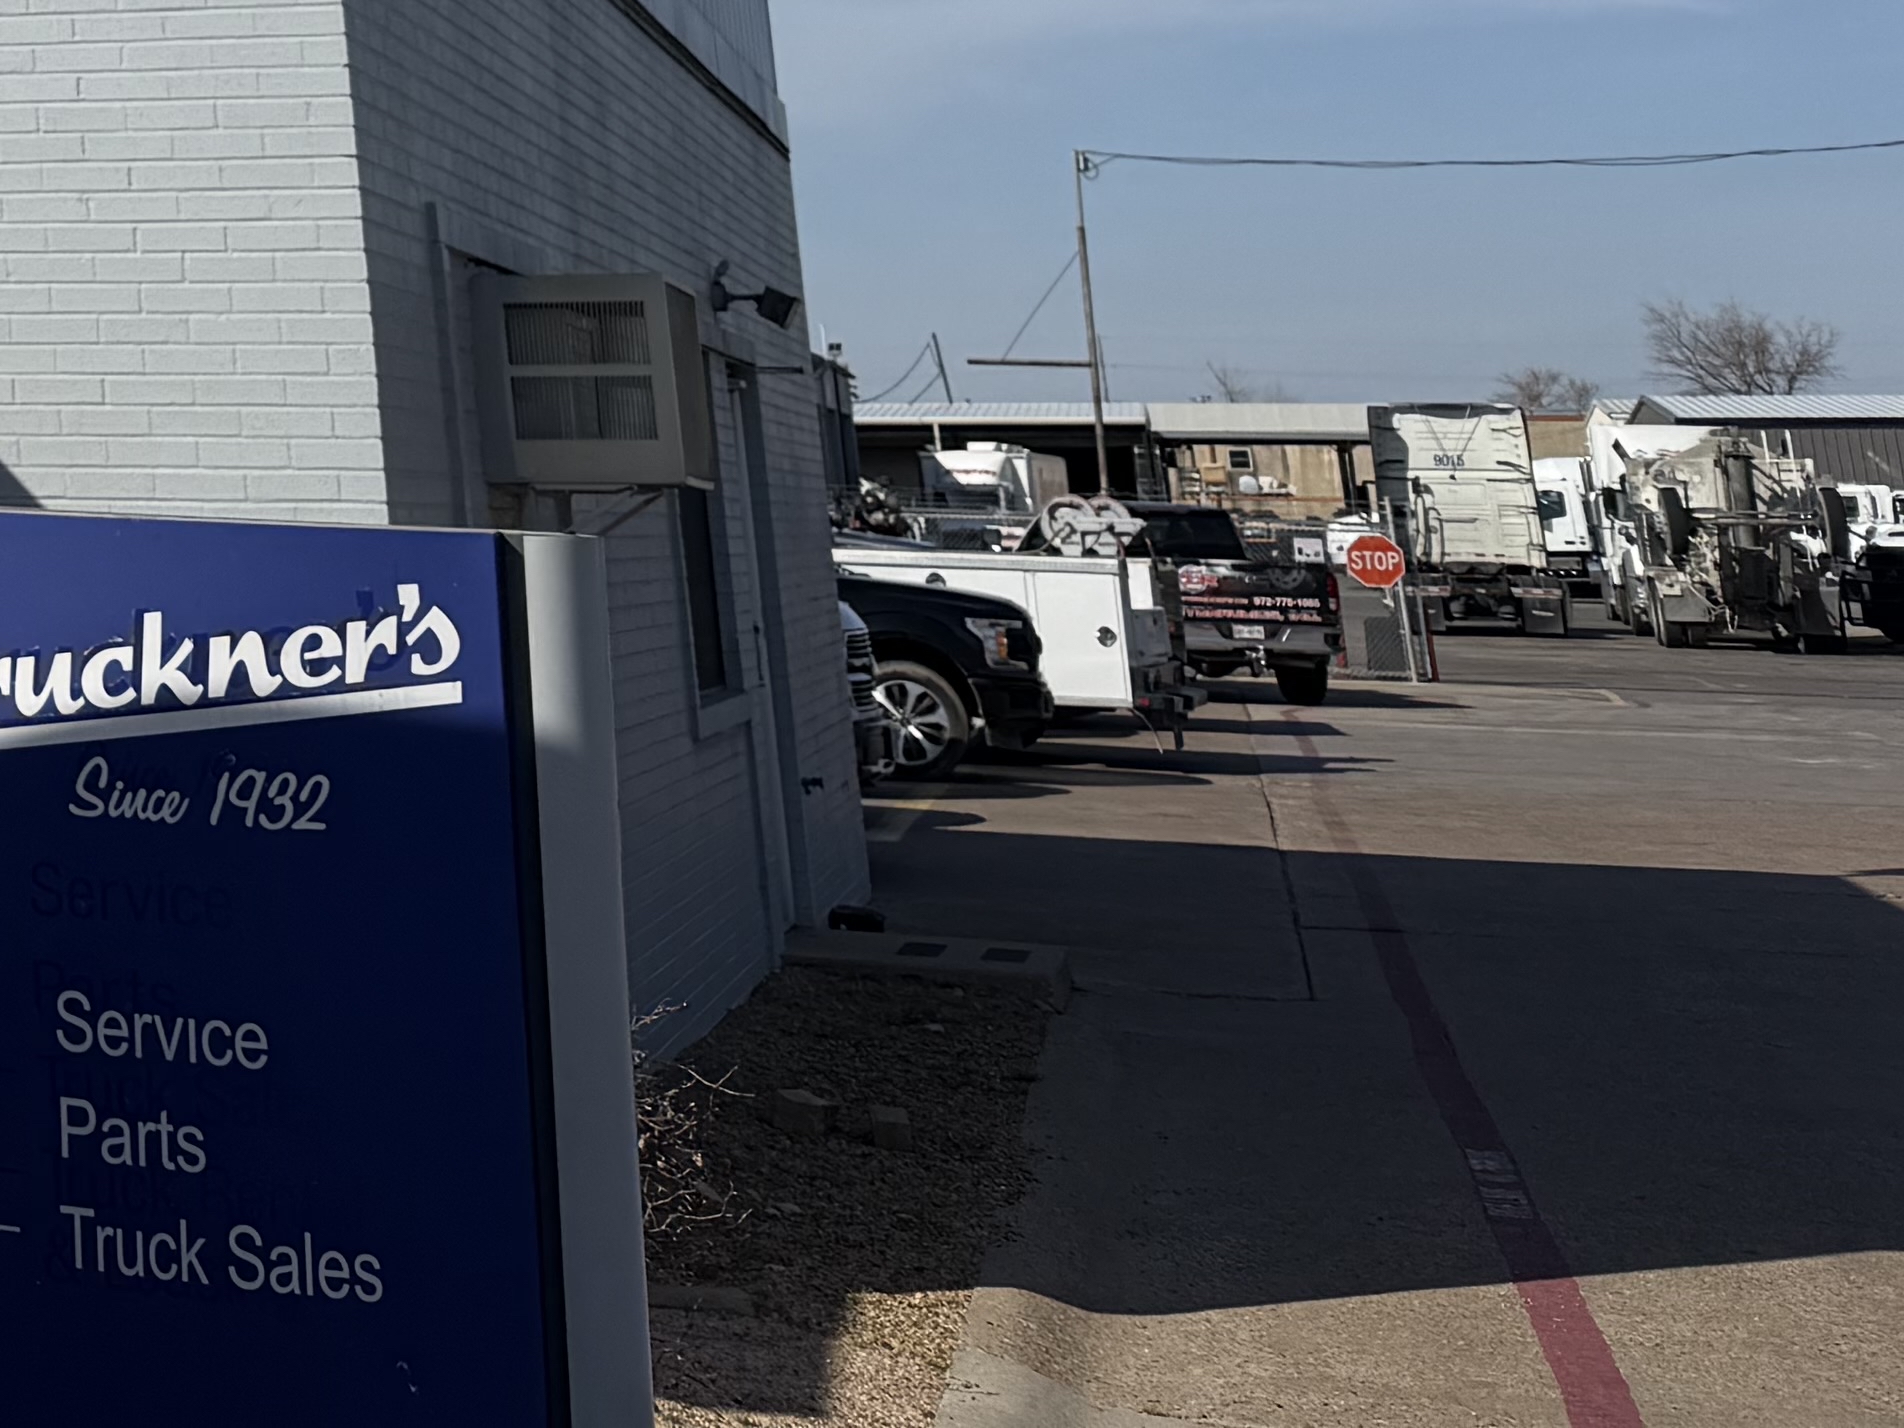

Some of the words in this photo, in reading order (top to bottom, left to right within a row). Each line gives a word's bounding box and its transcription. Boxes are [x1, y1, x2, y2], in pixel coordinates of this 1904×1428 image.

[1350, 550, 1400, 571] STOP
[68, 756, 190, 826] Since
[210, 769, 331, 831] 1932
[56, 991, 269, 1070] Service
[59, 1097, 206, 1173] Parts
[59, 1206, 209, 1284] Truck
[228, 1225, 383, 1302] Sales
